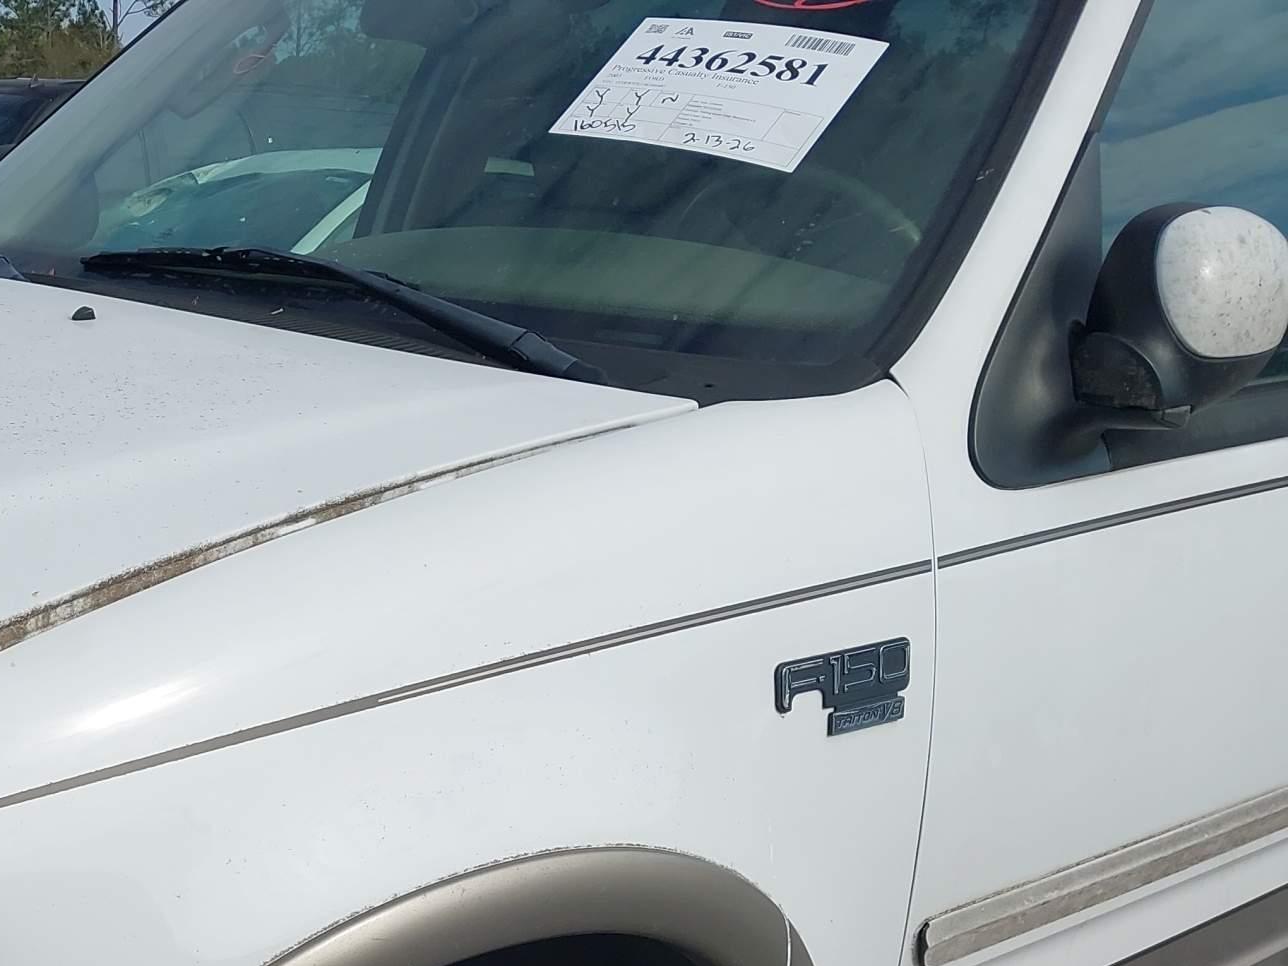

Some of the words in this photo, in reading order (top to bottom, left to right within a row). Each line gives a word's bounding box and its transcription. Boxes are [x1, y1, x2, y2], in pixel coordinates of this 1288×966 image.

[612, 64, 667, 75] Progressive
[668, 67, 708, 79] Casualty
[712, 71, 760, 86] Insurance
[636, 44, 829, 87] 44362581
[635, 89, 652, 106] Y
